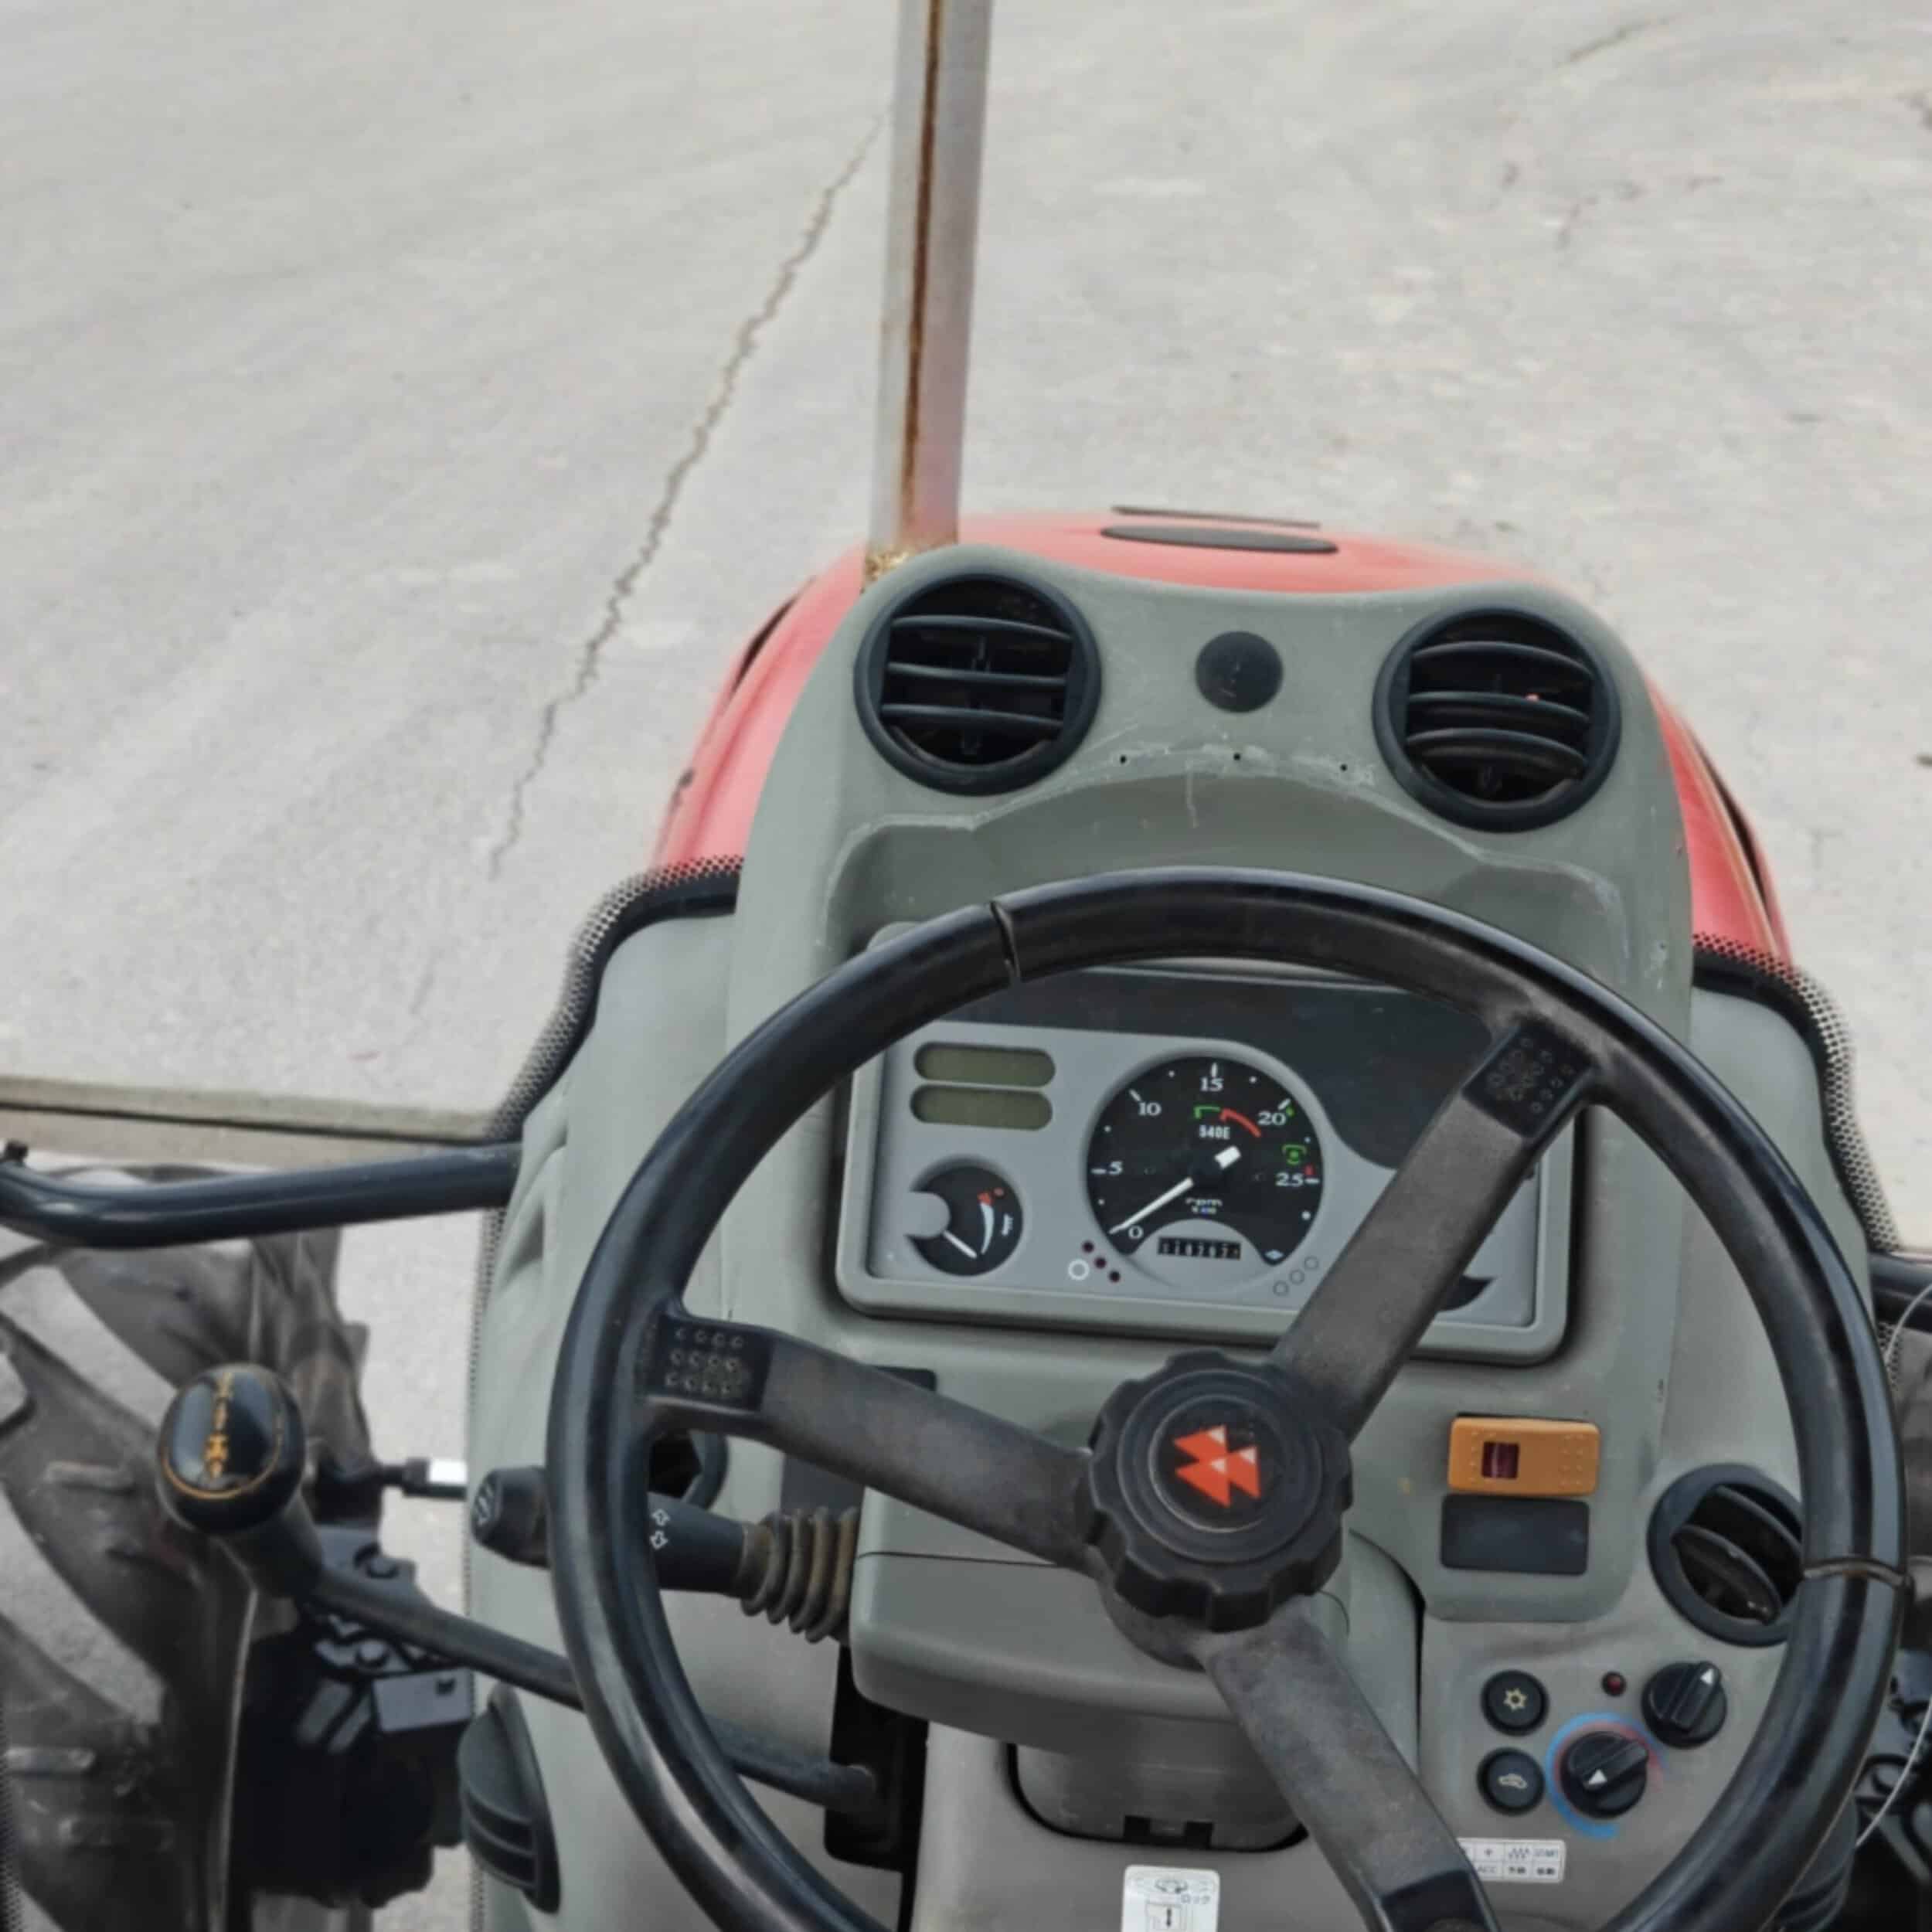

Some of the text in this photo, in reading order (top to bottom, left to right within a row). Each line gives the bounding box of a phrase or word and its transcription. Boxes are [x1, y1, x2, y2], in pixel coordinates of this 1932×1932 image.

[1200, 1077, 1223, 1092] 15
[1138, 1101, 1162, 1116] 10
[1258, 1111, 1286, 1126] 20
[1107, 1160, 1123, 1175] 5
[1276, 1172, 1304, 1187] 25
[1128, 1226, 1144, 1240] 0
